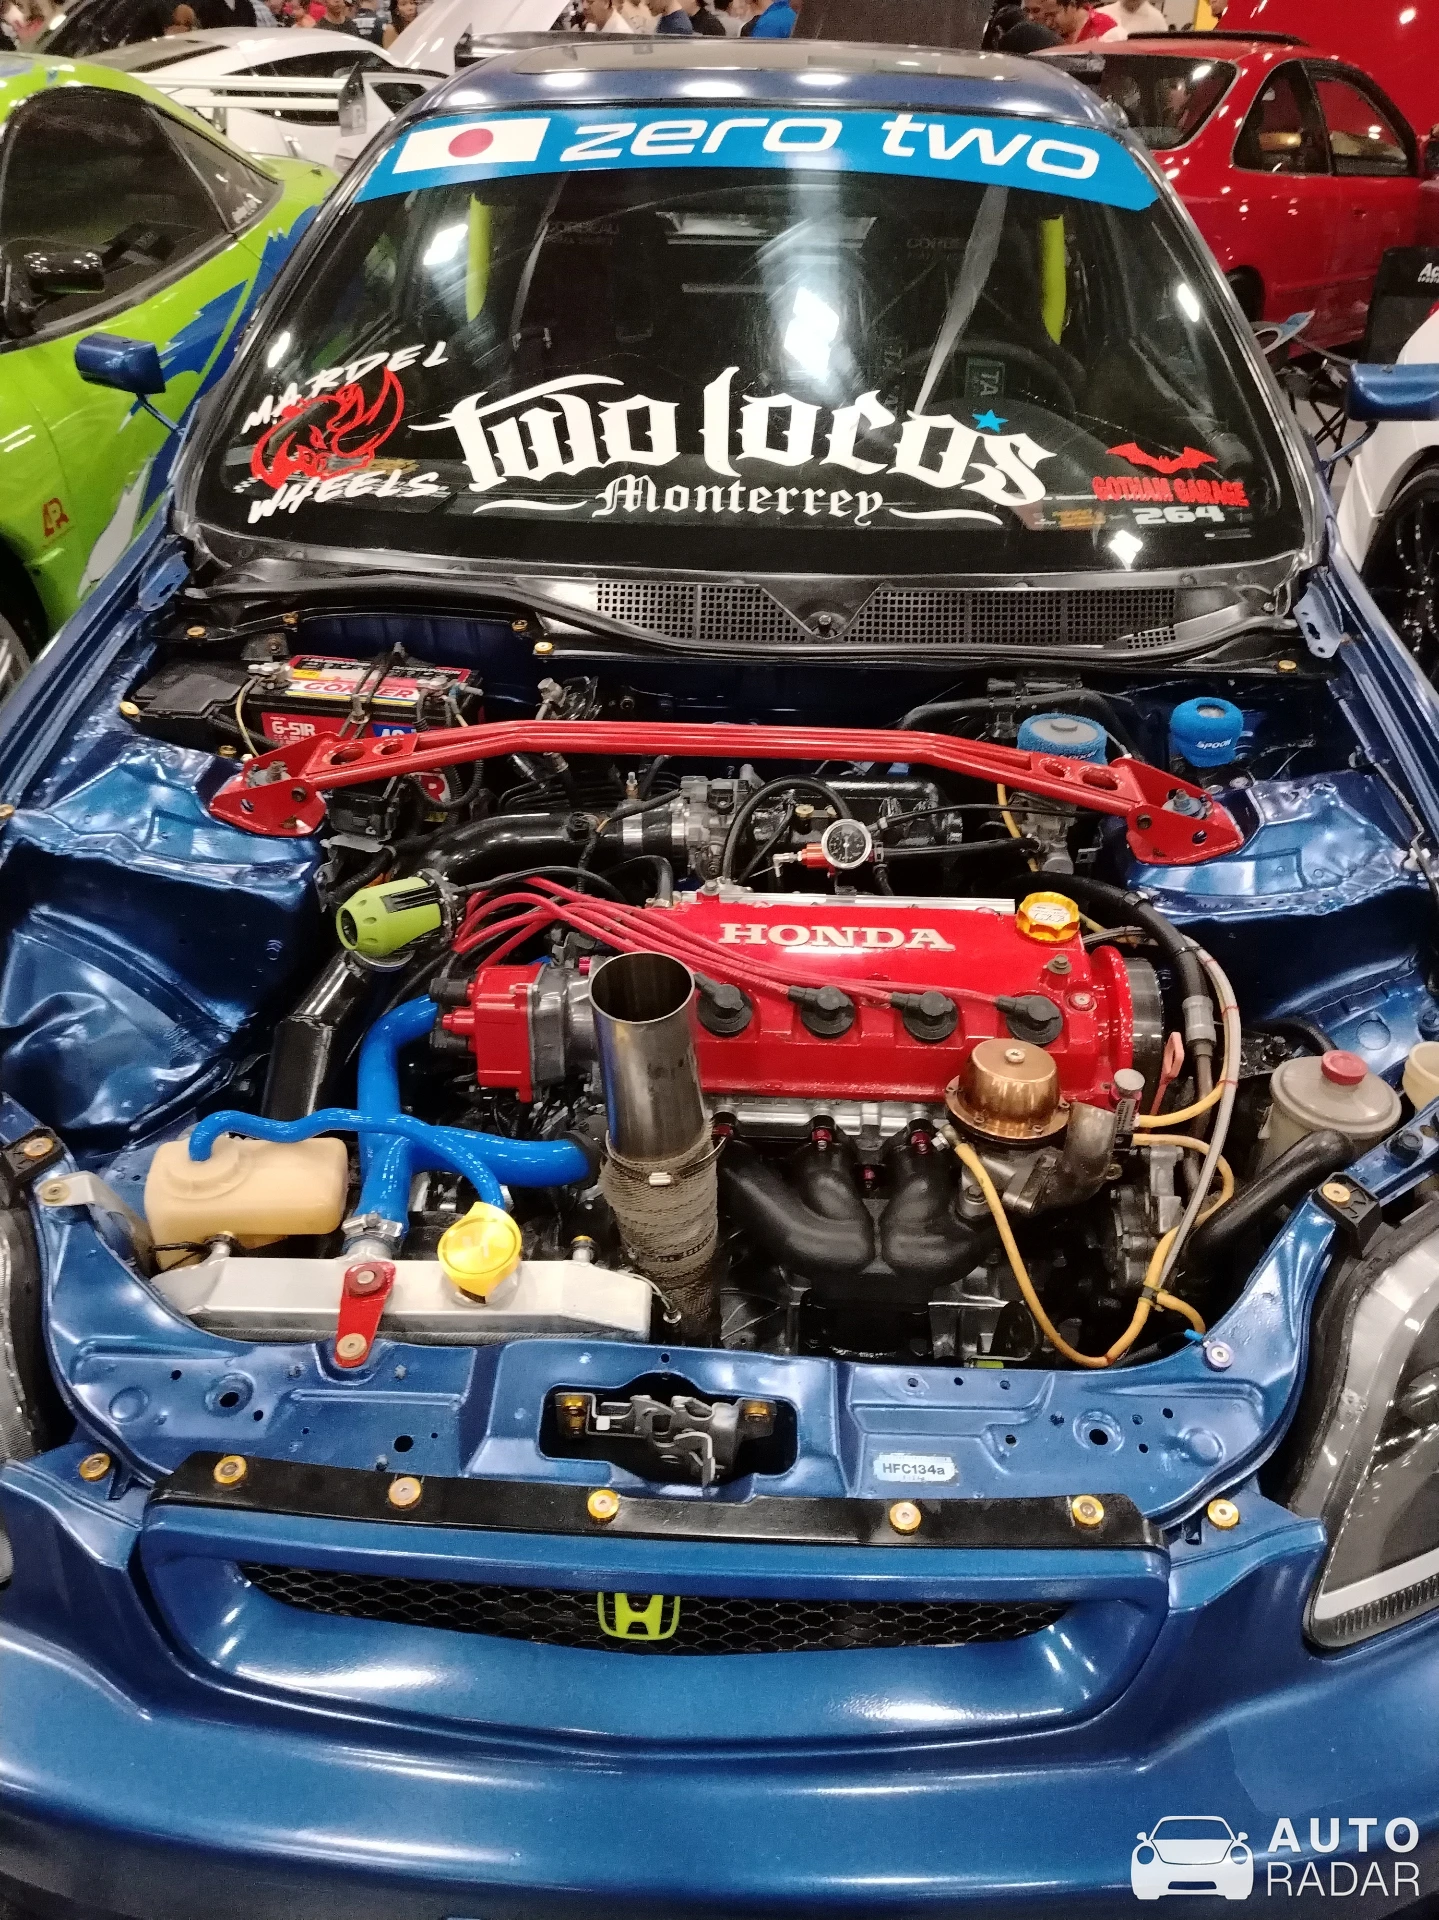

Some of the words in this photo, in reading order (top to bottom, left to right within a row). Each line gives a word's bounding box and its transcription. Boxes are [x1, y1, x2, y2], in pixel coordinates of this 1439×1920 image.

[559, 117, 843, 162] zero
[881, 113, 1100, 179] two
[241, 341, 449, 434] MARDEL
[247, 468, 440, 524] WHEELS
[592, 473, 883, 527] Monterrey
[1092, 476, 1174, 502] GOTHAM
[1173, 478, 1249, 507] GARAGE
[1132, 505, 1226, 525] 264
[718, 923, 956, 951] HONDA
[882, 1462, 946, 1475] HFC134a
